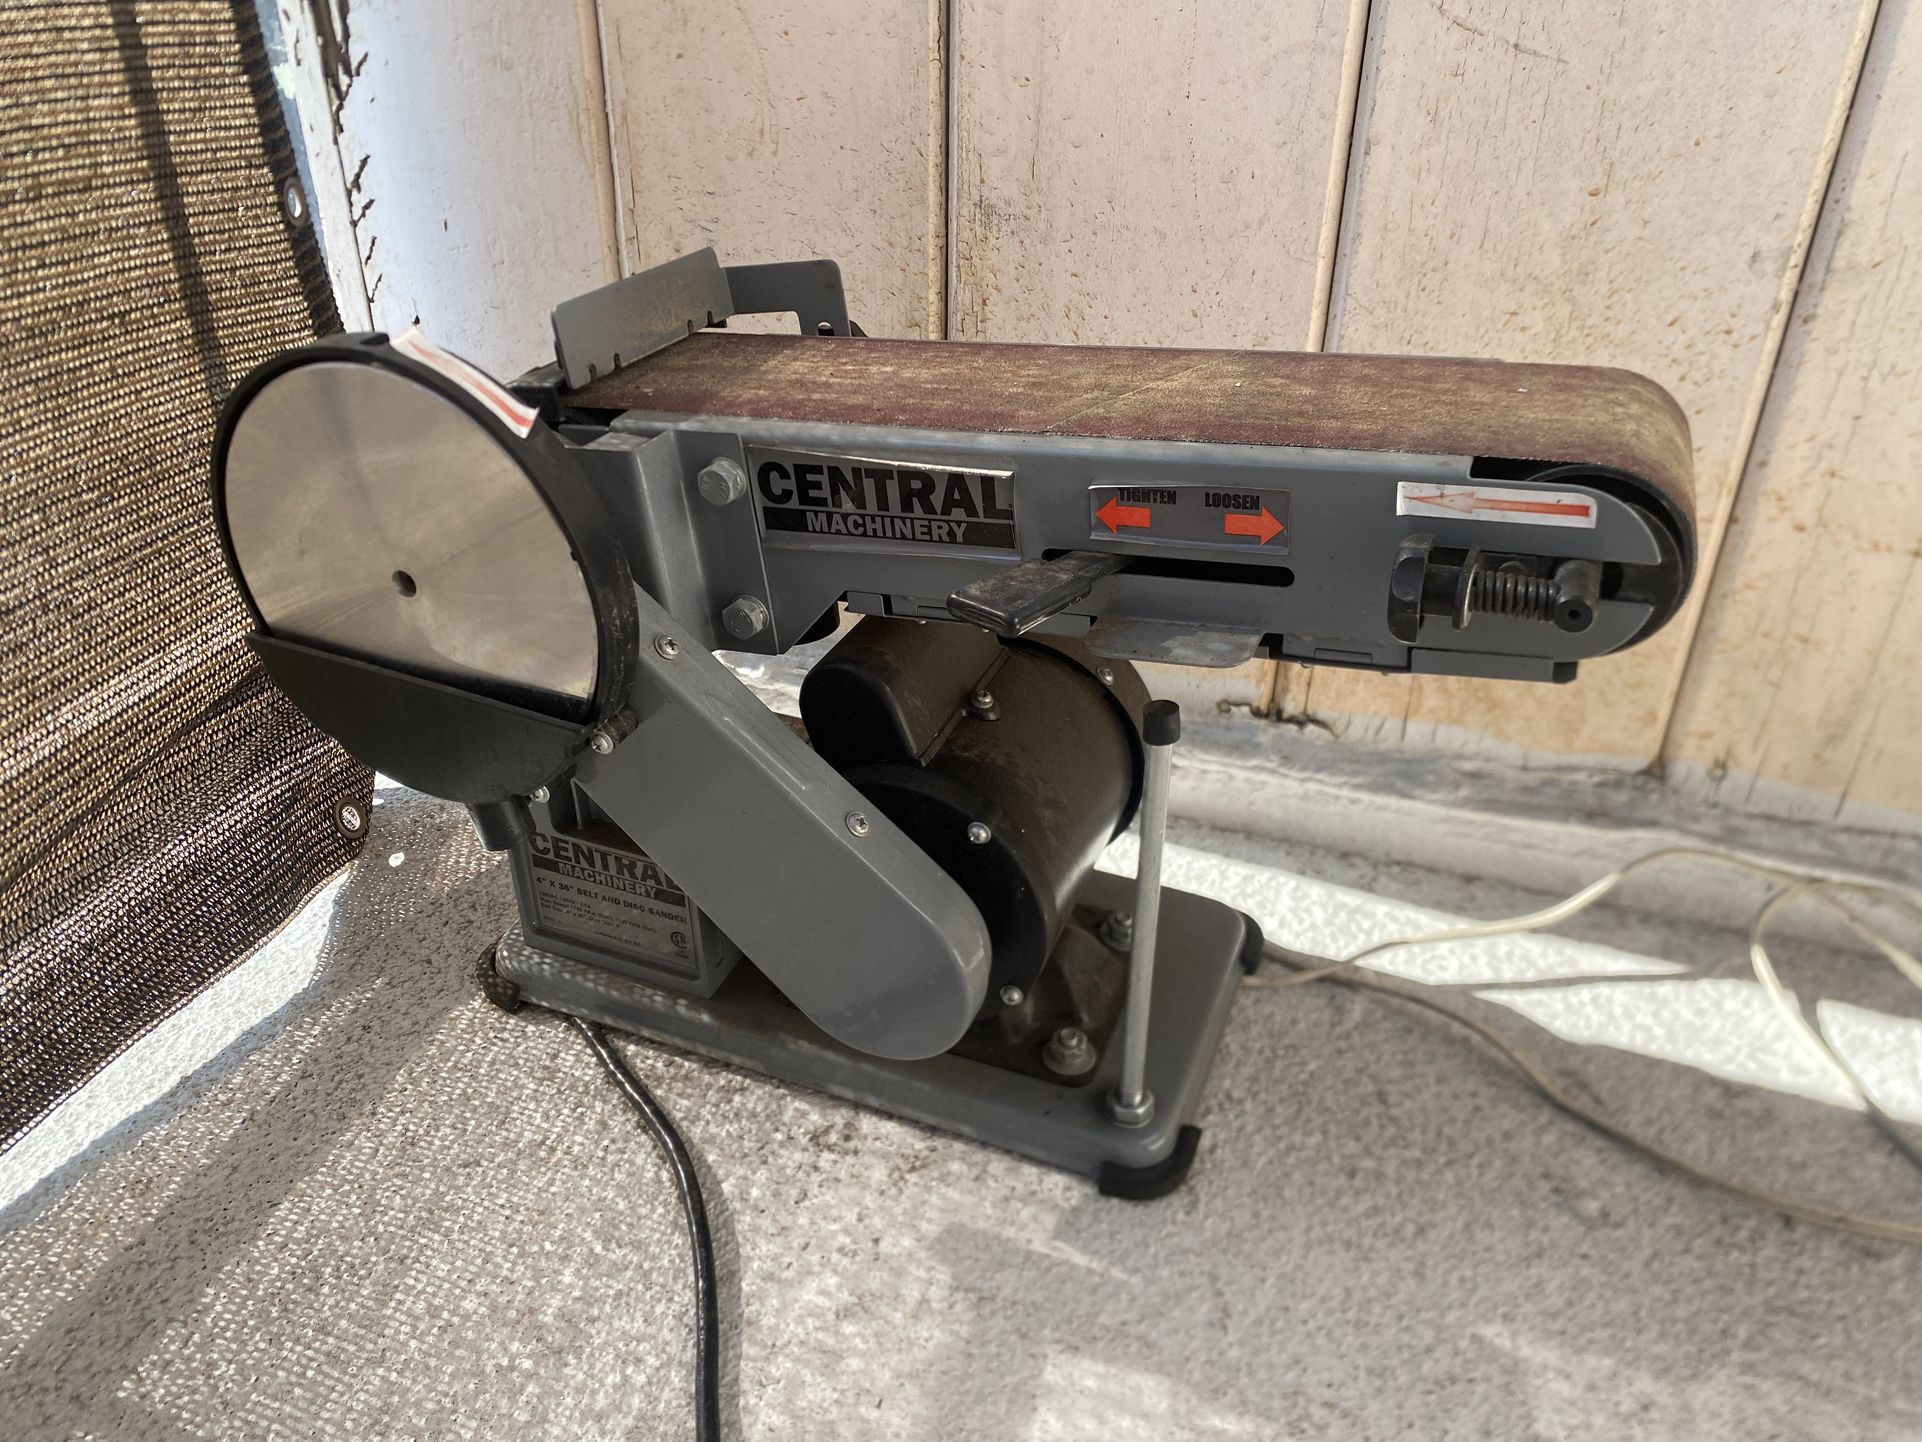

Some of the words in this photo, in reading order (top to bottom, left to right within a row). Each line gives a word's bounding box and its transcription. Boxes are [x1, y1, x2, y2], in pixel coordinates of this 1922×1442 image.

[757, 461, 1013, 520] CENTRAL
[1118, 487, 1177, 505] TIGHTEN
[1205, 492, 1261, 511] LOOSEN
[806, 511, 968, 543] MACHINERY
[558, 862, 657, 899] MACHINERY
[577, 888, 598, 900] BELT
[601, 895, 621, 905] AND
[623, 900, 646, 913] DISC
[648, 907, 688, 925] SANDER
